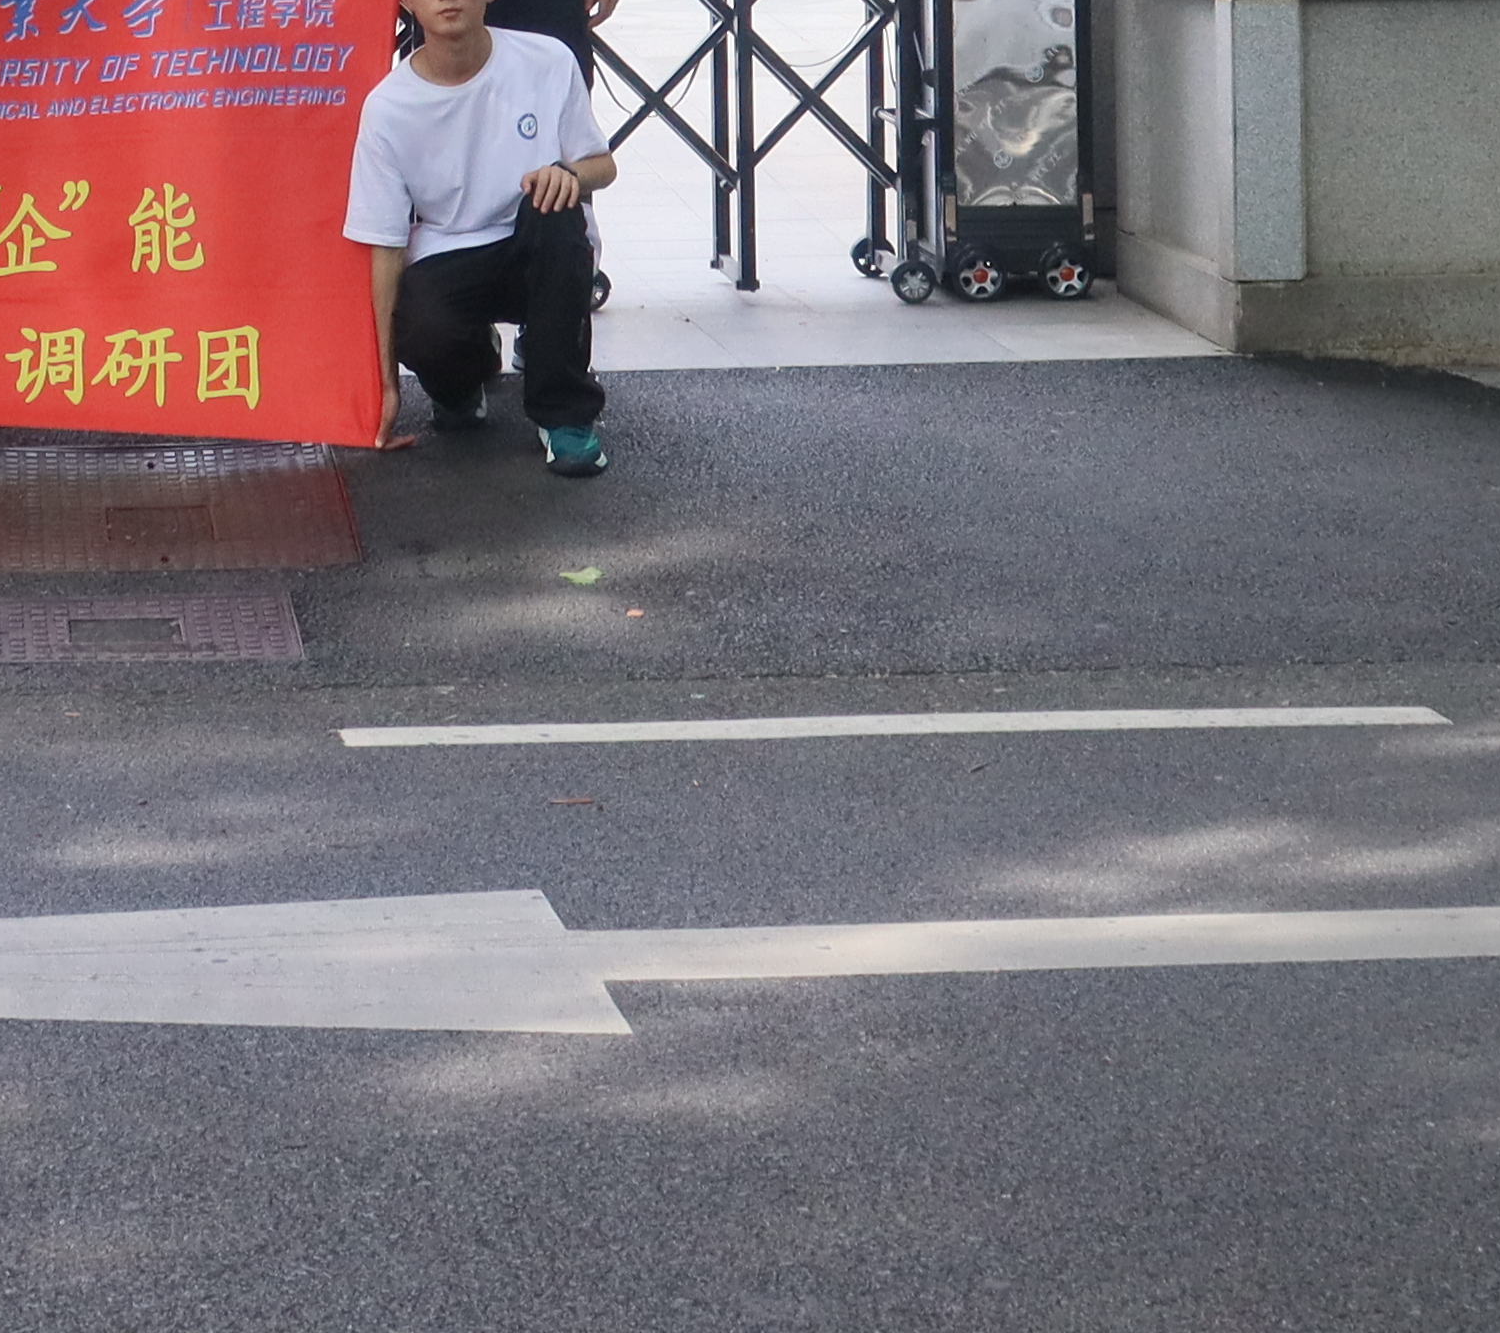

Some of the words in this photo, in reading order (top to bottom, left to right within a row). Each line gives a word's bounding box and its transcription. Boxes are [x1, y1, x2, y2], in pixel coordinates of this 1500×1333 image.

[99, 53, 142, 83] OF
[151, 43, 355, 79] TECHNOLOGY
[46, 97, 87, 119] AND
[89, 89, 210, 116] ELECTRONIC
[211, 85, 347, 109] ENGINEERING
